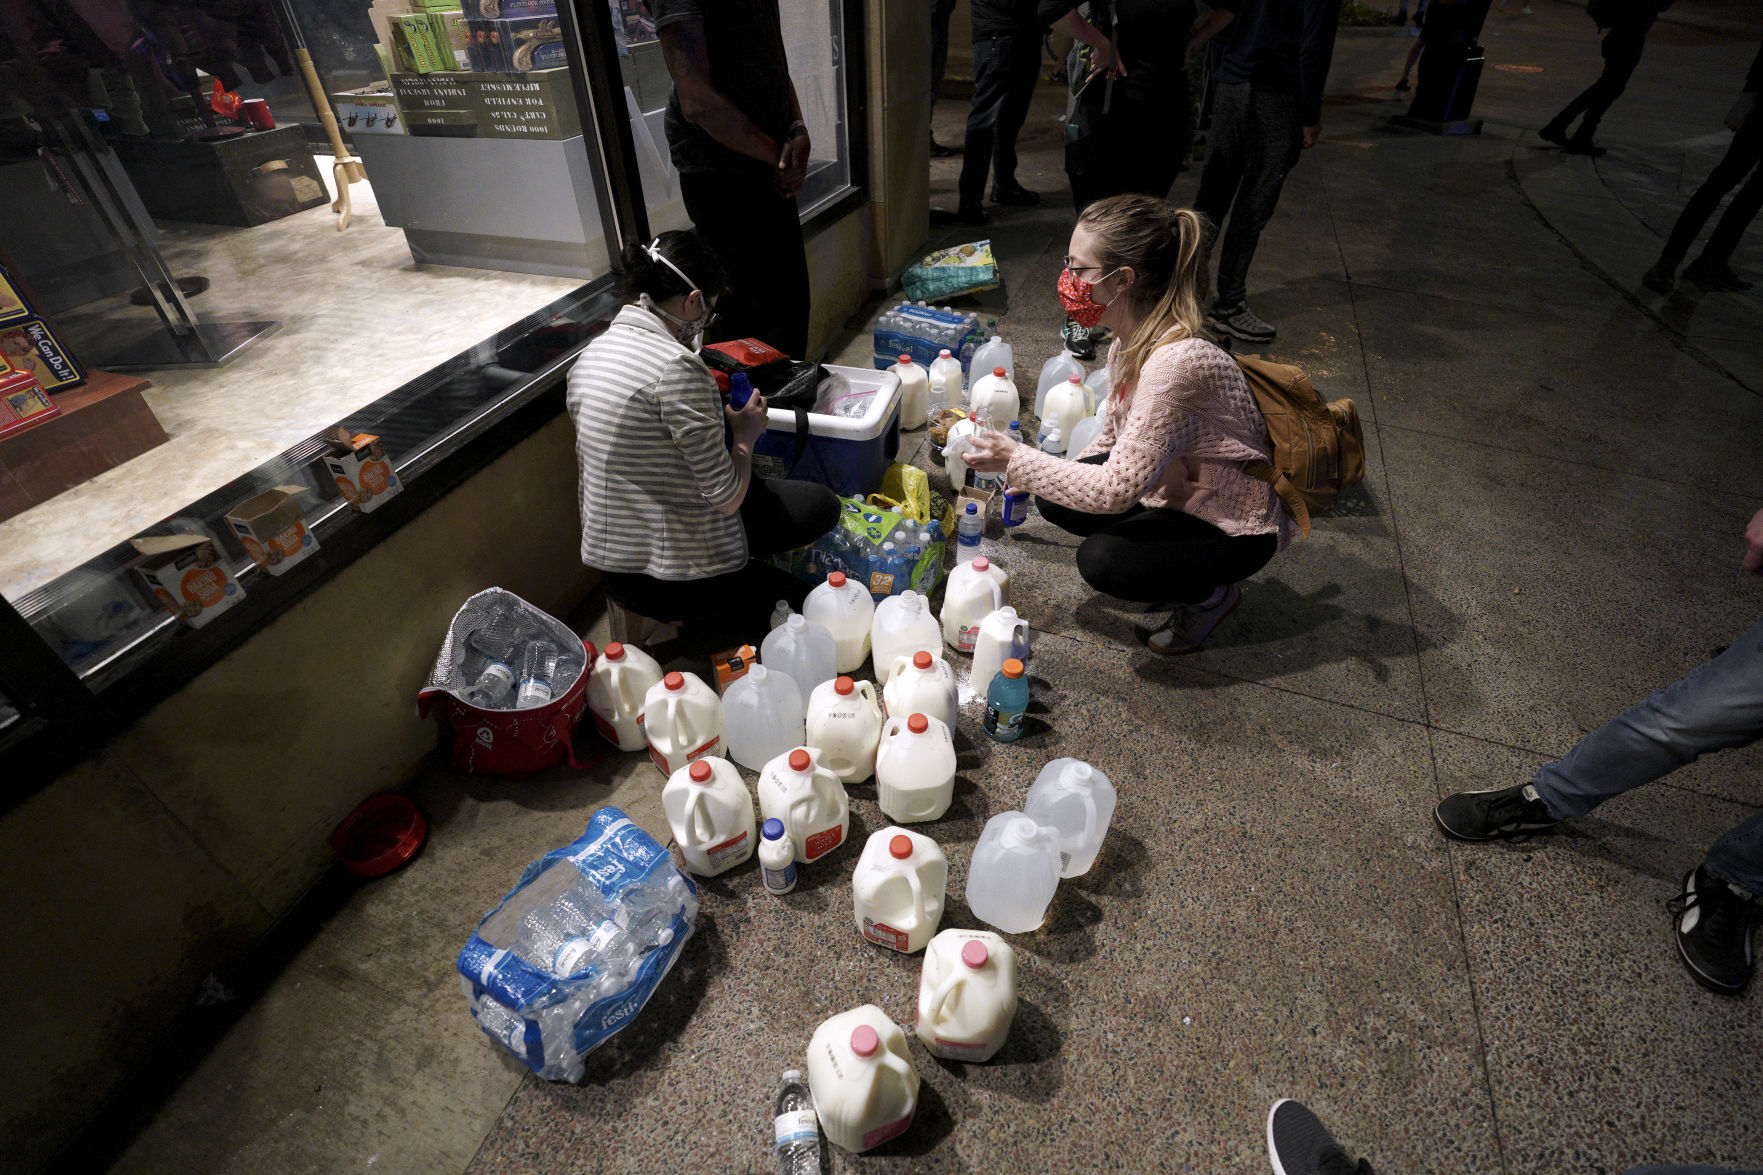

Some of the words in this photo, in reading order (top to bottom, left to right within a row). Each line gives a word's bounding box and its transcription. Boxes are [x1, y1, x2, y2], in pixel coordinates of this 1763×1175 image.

[480, 83, 513, 91] MUSKET
[514, 83, 540, 91] RIFLE
[433, 88, 467, 96] INDIANA
[484, 97, 522, 106] ENFIELD
[525, 97, 544, 106] FOR
[494, 123, 527, 133] ROUNDS
[529, 125, 549, 134] 1000
[28, 324, 43, 340] We
[38, 340, 53, 356] Can
[49, 356, 63, 370] Do
[59, 368, 75, 381] It!
[188, 572, 216, 595] BAKING
[872, 574, 892, 586] 32
[198, 582, 218, 599] SODA
